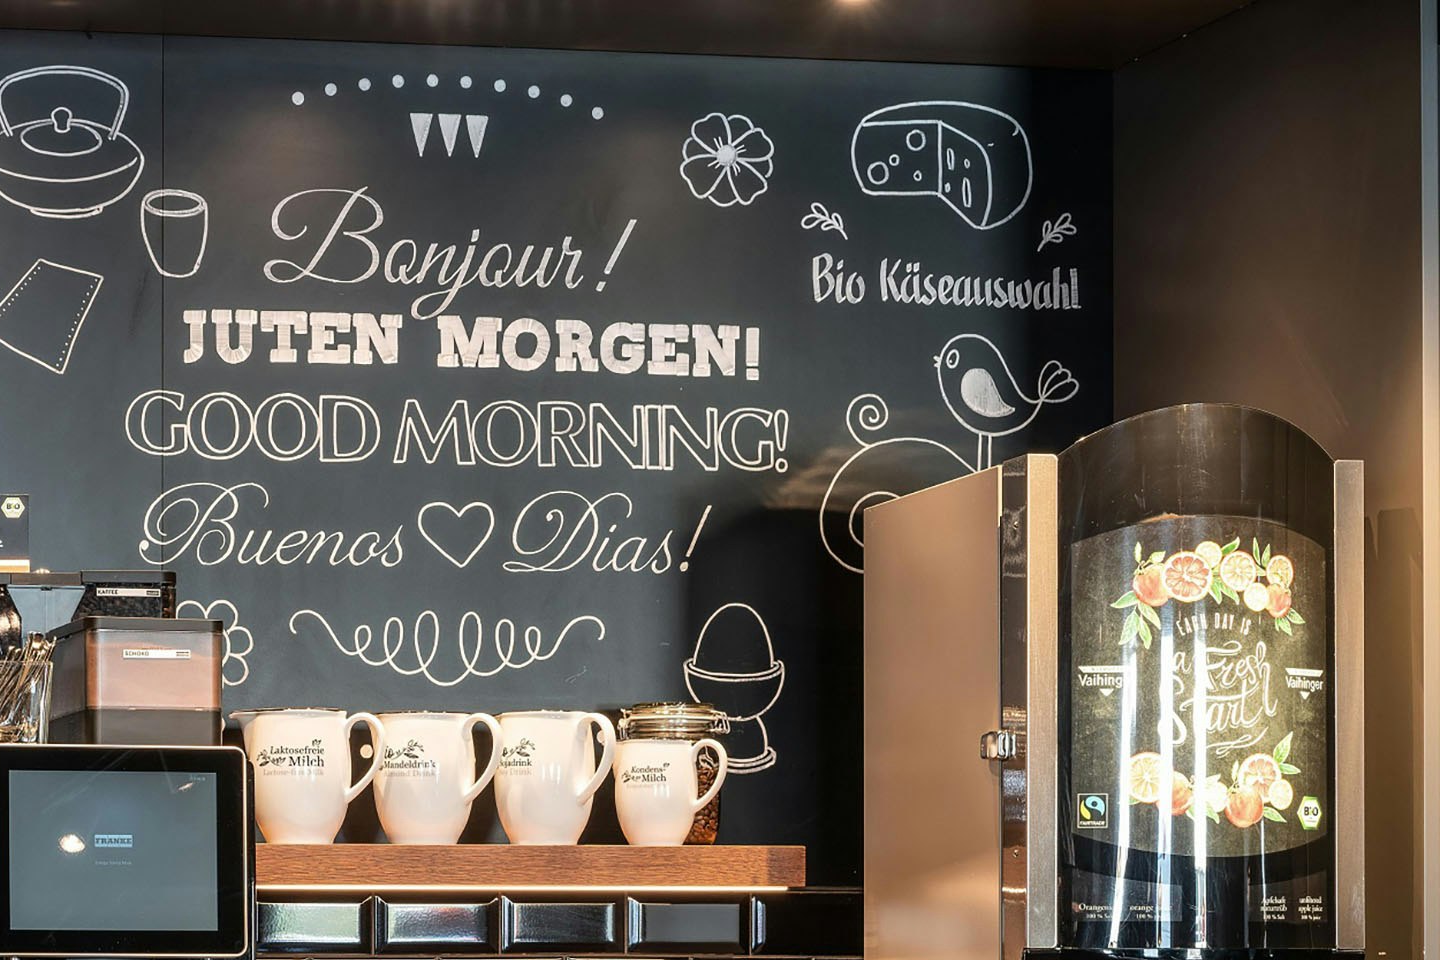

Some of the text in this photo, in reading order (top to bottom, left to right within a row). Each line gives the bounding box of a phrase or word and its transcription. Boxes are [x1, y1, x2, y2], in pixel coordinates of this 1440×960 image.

[812, 253, 1082, 310] Bio Käseauswahl
[183, 309, 760, 381] JUTEN MORGEN!
[125, 389, 789, 473] GOOD MORNING!
[137, 481, 404, 568] Buenos
[1214, 612, 1235, 631] DAY
[1240, 617, 1251, 636] IS
[1077, 673, 1123, 689] Vaihing
[1284, 675, 1324, 693] Vaihinger
[270, 746, 325, 755] Laktosefreie
[288, 755, 325, 767] Milch
[642, 773, 667, 782] Milch
[95, 836, 133, 846] FRANKE
[1129, 905, 1154, 913] orange
